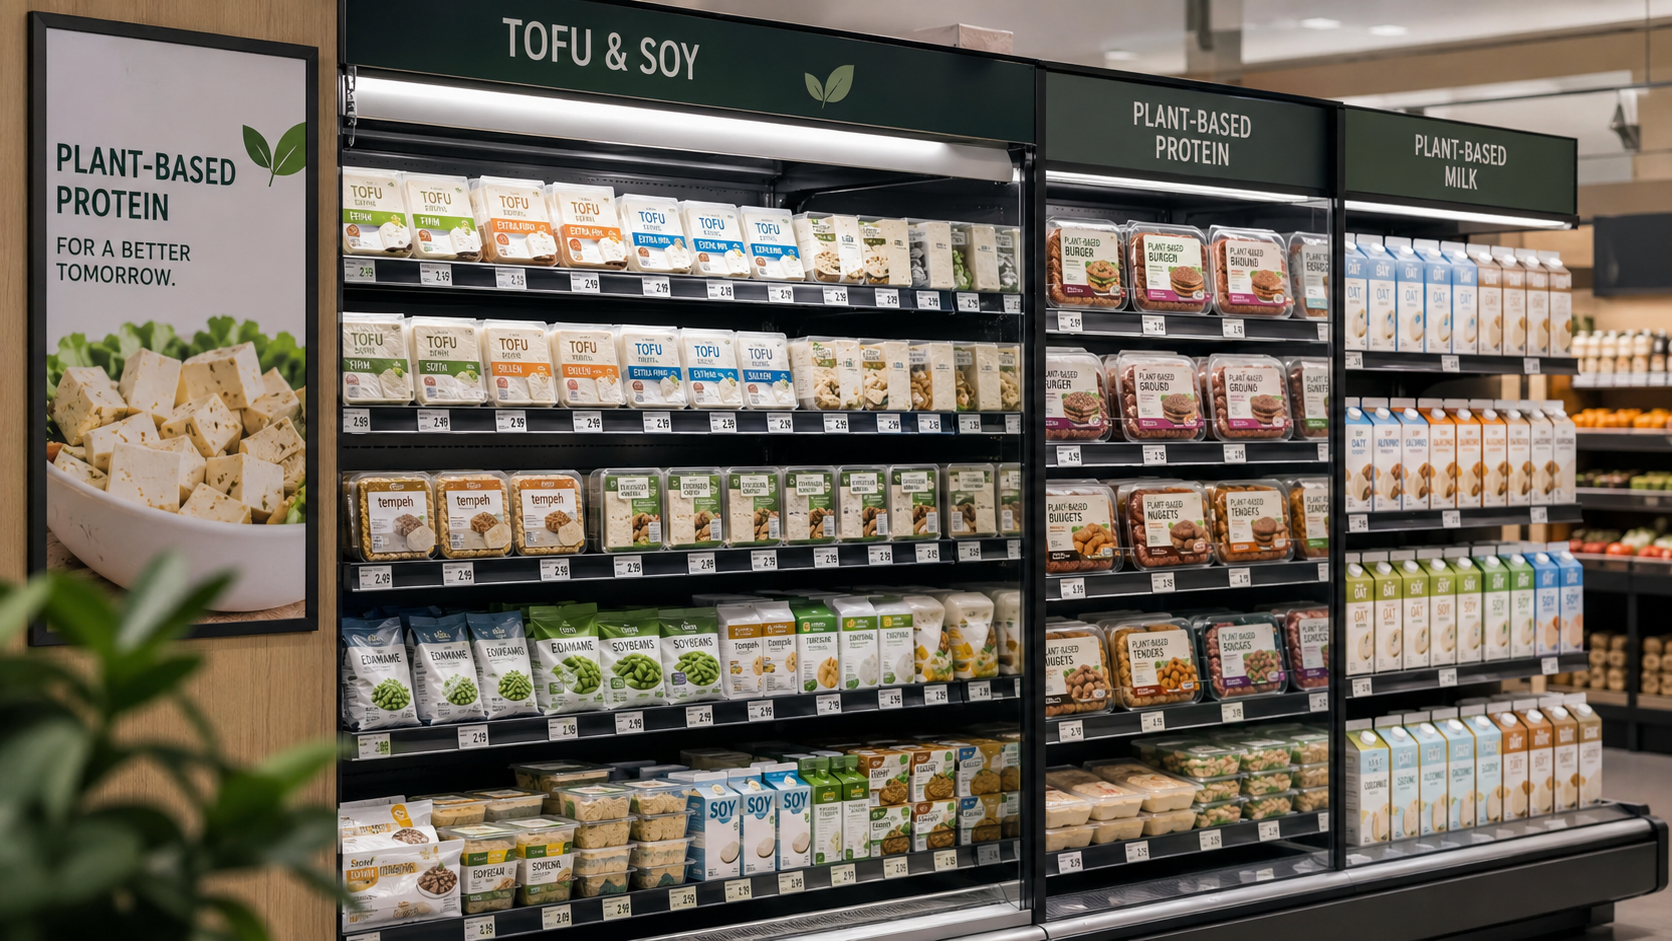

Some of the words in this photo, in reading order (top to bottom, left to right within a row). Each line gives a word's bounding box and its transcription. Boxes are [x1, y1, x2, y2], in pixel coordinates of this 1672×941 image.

[502, 17, 592, 66] TOFU
[605, 32, 628, 71] &
[639, 36, 700, 80] SOY
[1133, 101, 1252, 138] PLANT-BASED
[1155, 135, 1230, 166] PROTEIN
[1415, 133, 1507, 166] PLANT-BASED
[56, 143, 236, 186] PLANT-BASED
[1444, 166, 1478, 190] MILK
[350, 185, 383, 199] TOFU
[420, 191, 452, 205] TOFU
[56, 186, 169, 221] PROTEIN
[499, 195, 529, 210] TOFU
[570, 201, 600, 215] TOFU
[638, 211, 666, 224] TOFU
[698, 217, 725, 230] TOFU
[755, 222, 780, 235] TOFU
[56, 236, 95, 256] FOR
[101, 240, 115, 257] A
[121, 241, 191, 261] BETTER
[1065, 246, 1094, 258] BURGER
[56, 263, 176, 286] TOMORROW.
[351, 333, 383, 346] TOFU
[426, 336, 457, 349] TOFU
[499, 338, 529, 351] TOFU
[569, 341, 597, 354] TOFU
[635, 343, 662, 356] TOFU
[694, 345, 720, 358] TOFU
[748, 348, 773, 360] TOFU
[378, 495, 414, 509] tempeh
[456, 494, 490, 508] tempeh
[531, 492, 564, 507] tempeh
[1354, 610, 1368, 623] OAT
[1383, 608, 1396, 620] OAT
[747, 796, 773, 814] SOY
[783, 791, 808, 809] SOY
[710, 800, 737, 819] SOY
